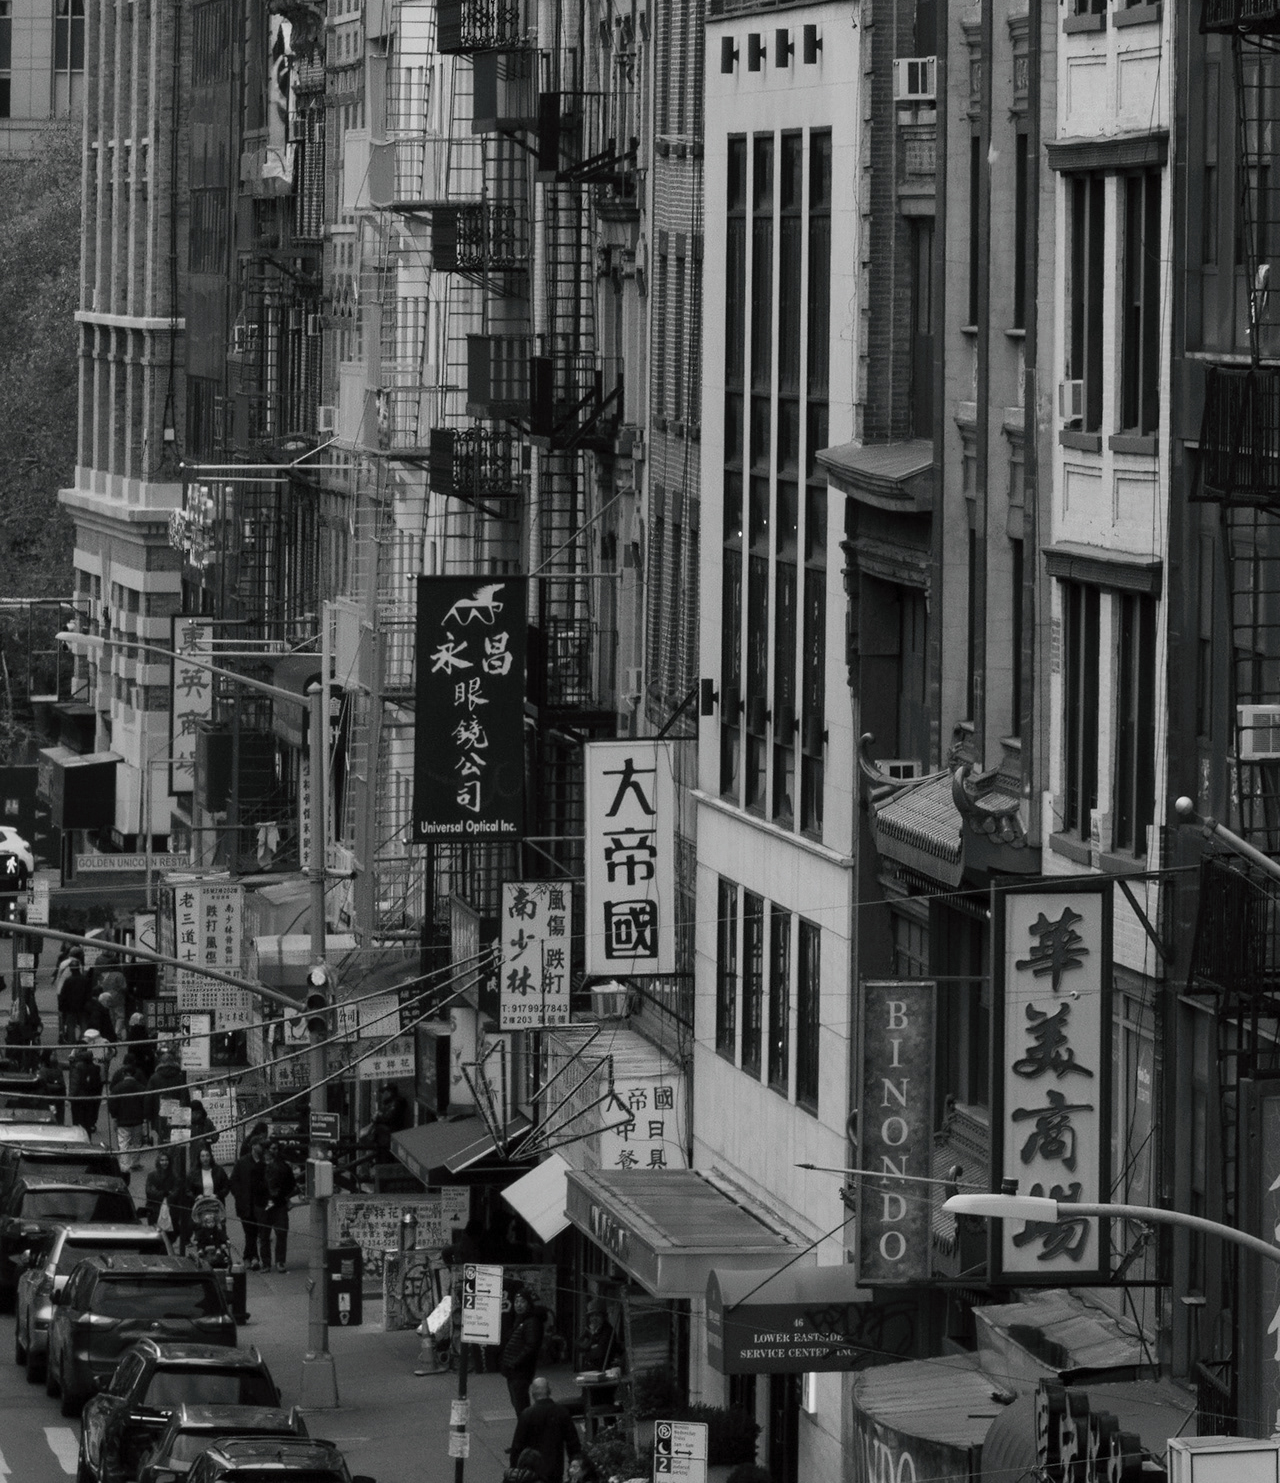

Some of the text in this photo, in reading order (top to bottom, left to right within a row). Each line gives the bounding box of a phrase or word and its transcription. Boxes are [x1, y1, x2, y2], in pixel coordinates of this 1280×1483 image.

[430, 631, 513, 675] 永昌
[451, 676, 490, 813] 眼鏡公司
[421, 819, 517, 835] Universal Optical Inc.
[78, 858, 191, 868] GOLDEN UNICON RESTA
[602, 756, 658, 960] 大帝國
[178, 891, 198, 962] 老三道士
[506, 886, 538, 997] 南少林
[878, 1000, 911, 1262] BINONDO
[793, 1318, 804, 1327] 46
[740, 1348, 786, 1359] SERVICE
[753, 1333, 791, 1344] LOWER
[658, 1457, 668, 1472] 2
